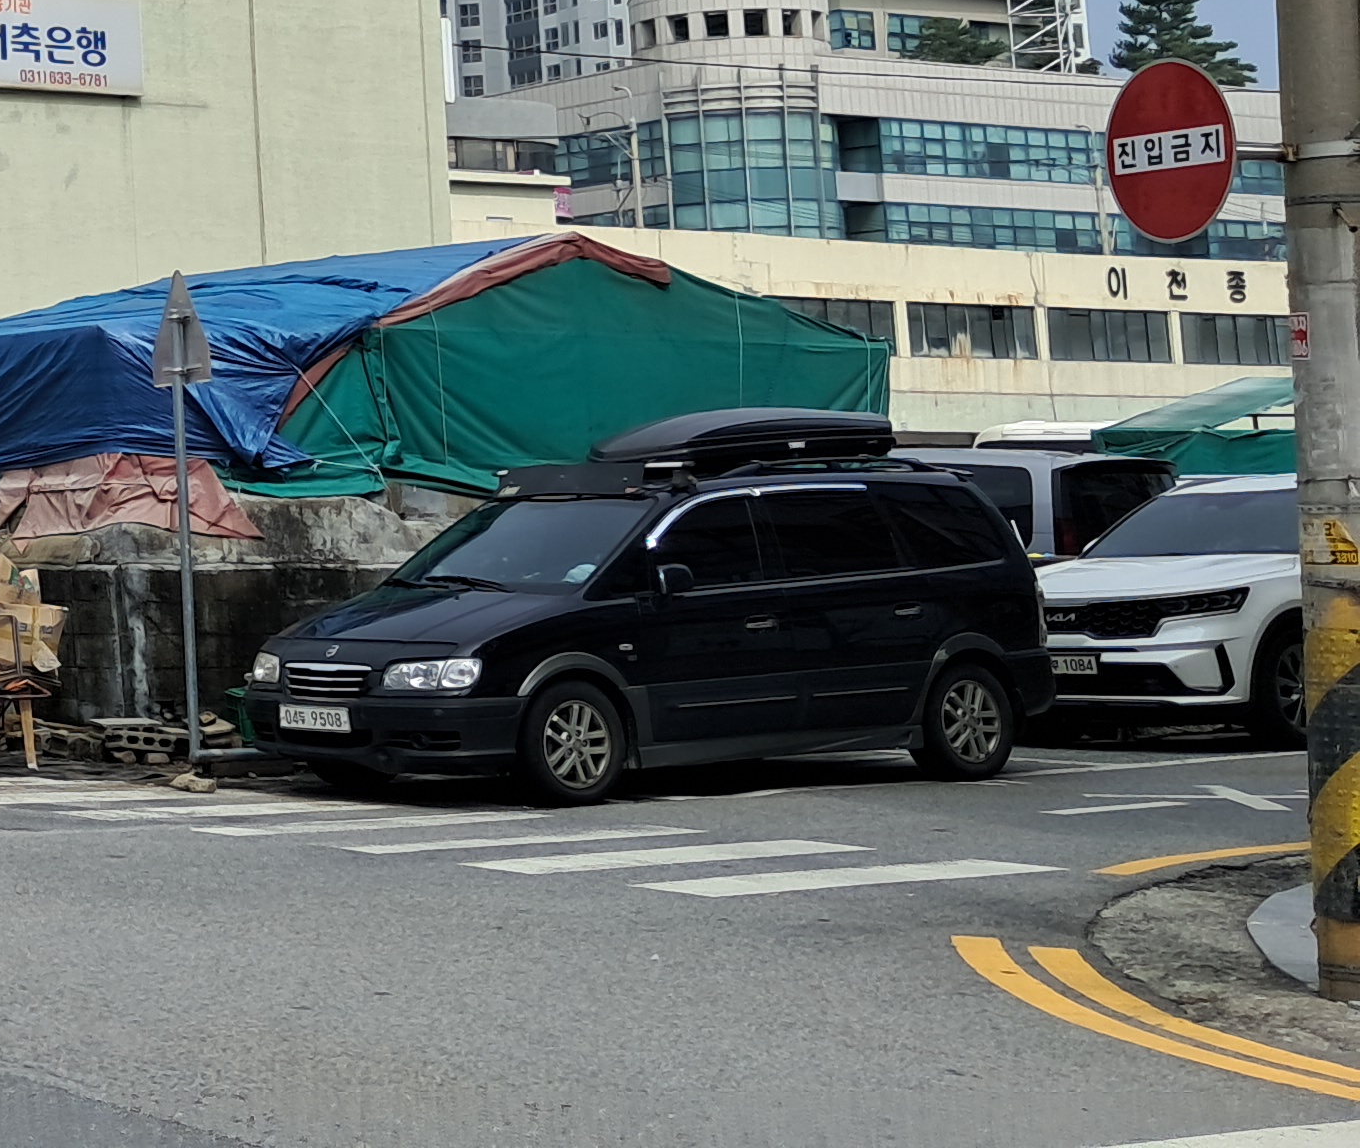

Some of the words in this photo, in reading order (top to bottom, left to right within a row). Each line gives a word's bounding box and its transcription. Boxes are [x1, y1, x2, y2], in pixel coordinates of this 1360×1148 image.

[1118, 128, 1221, 169] 진입금지
[1107, 266, 1247, 304] 이천종
[1063, 658, 1093, 672] 1084
[311, 711, 342, 728] 9508
